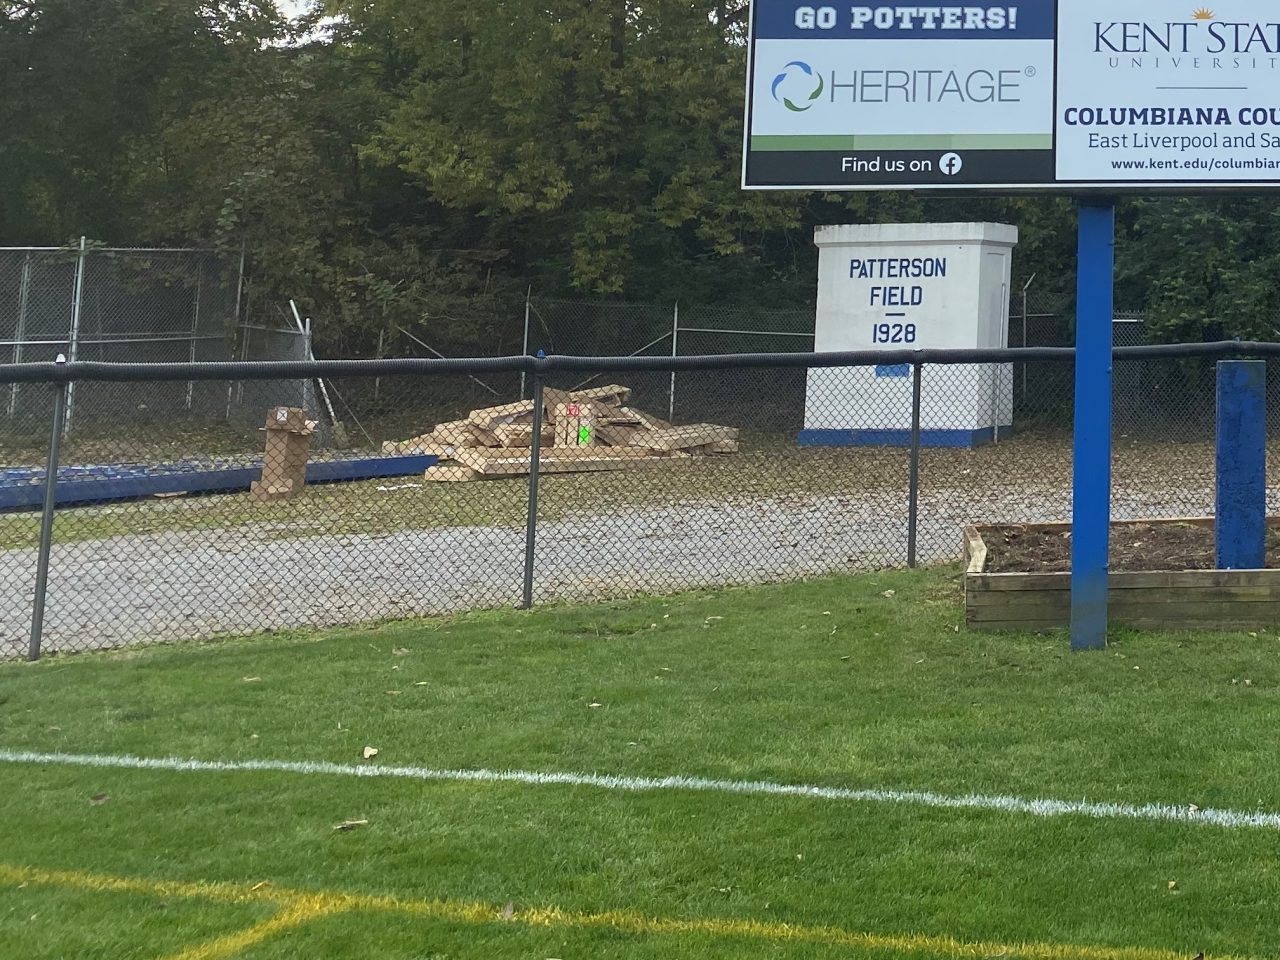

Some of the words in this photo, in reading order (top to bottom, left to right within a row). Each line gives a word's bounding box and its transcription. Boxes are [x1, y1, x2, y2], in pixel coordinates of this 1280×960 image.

[794, 6, 838, 30] GO
[850, 6, 1018, 30] POTTERS!
[1093, 22, 1199, 53] KENT
[830, 69, 1021, 103] HERITAGE
[1064, 107, 1232, 126] COLUMBIANA
[1088, 132, 1129, 148] East
[1132, 132, 1218, 151] Liverpool
[1222, 132, 1256, 148] and
[842, 157, 881, 172] Find
[885, 160, 905, 172] us
[910, 160, 932, 172] on
[850, 257, 947, 279] PATTERSON
[870, 286, 923, 307] FIELD
[872, 323, 917, 344] 1928
